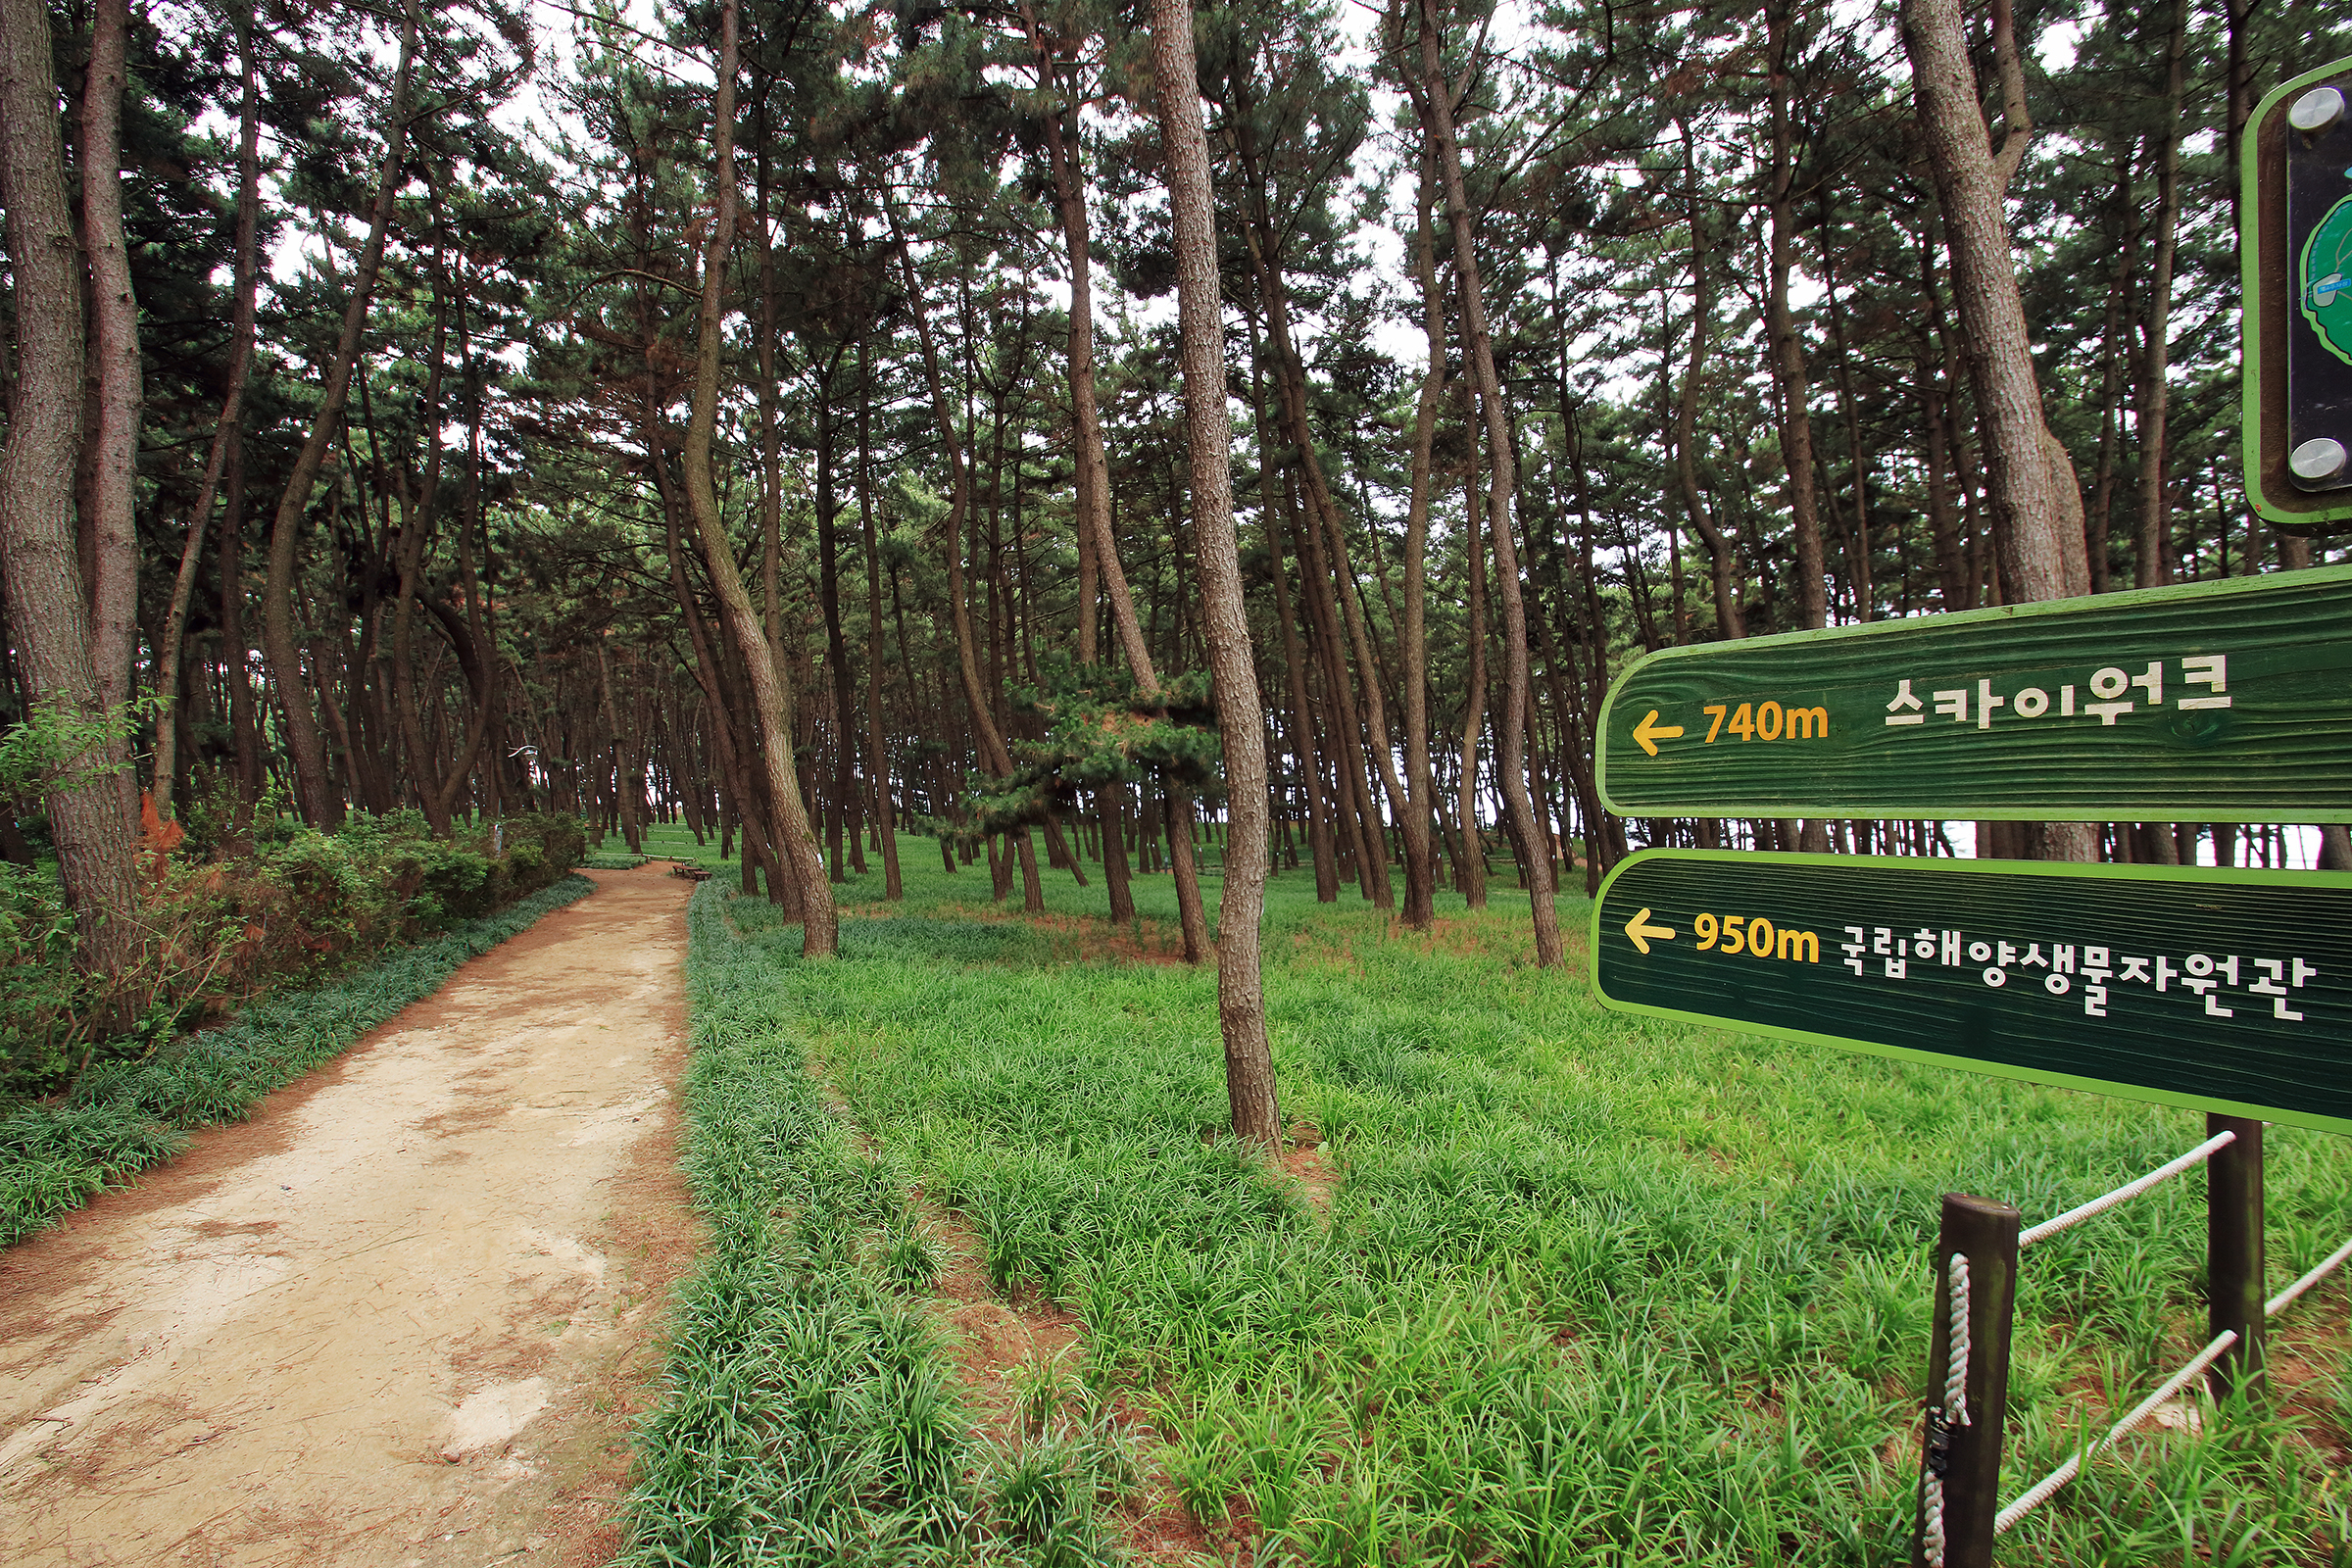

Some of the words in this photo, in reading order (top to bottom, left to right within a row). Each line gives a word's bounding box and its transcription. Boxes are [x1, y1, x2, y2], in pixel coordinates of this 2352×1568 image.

[1703, 701, 1829, 744] 740m
[1885, 655, 2232, 729] 스카이워크
[1693, 912, 1820, 963] 950m
[1841, 926, 2317, 1021] 국립해양생물자원관
